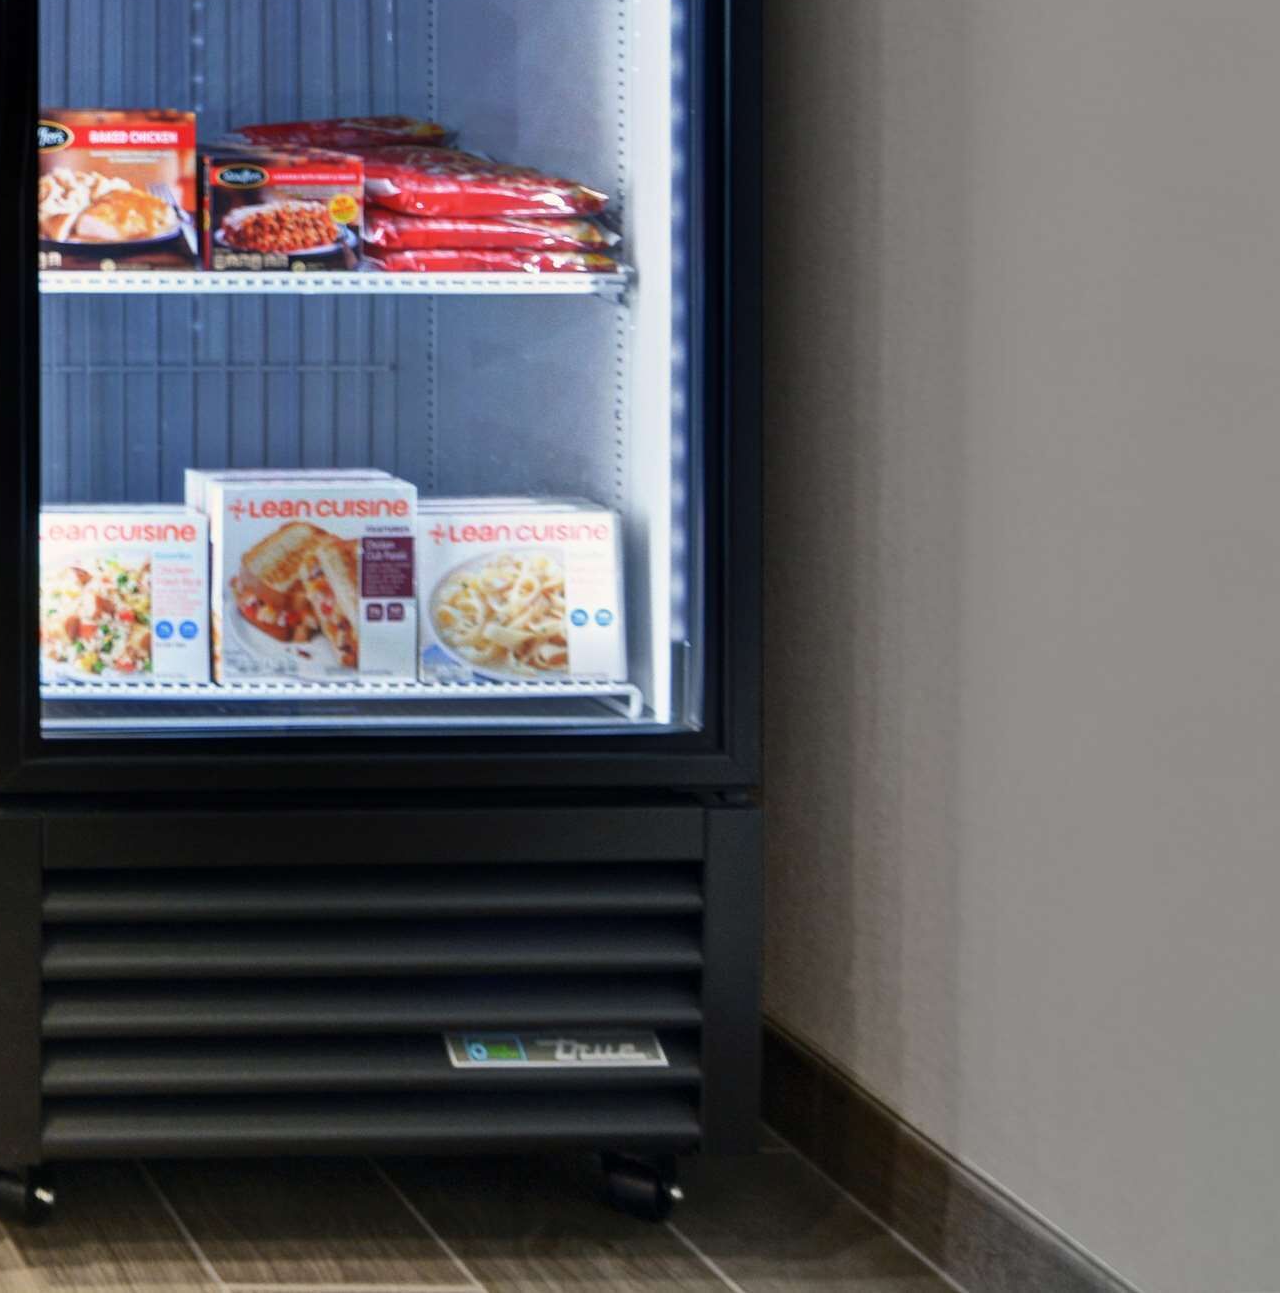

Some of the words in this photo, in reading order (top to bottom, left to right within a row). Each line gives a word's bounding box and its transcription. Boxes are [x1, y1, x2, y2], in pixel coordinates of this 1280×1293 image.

[248, 499, 311, 518] Lean
[315, 499, 409, 518] cuisine
[37, 524, 98, 542] ean
[103, 524, 198, 542] cuisine
[448, 524, 510, 543] Lean
